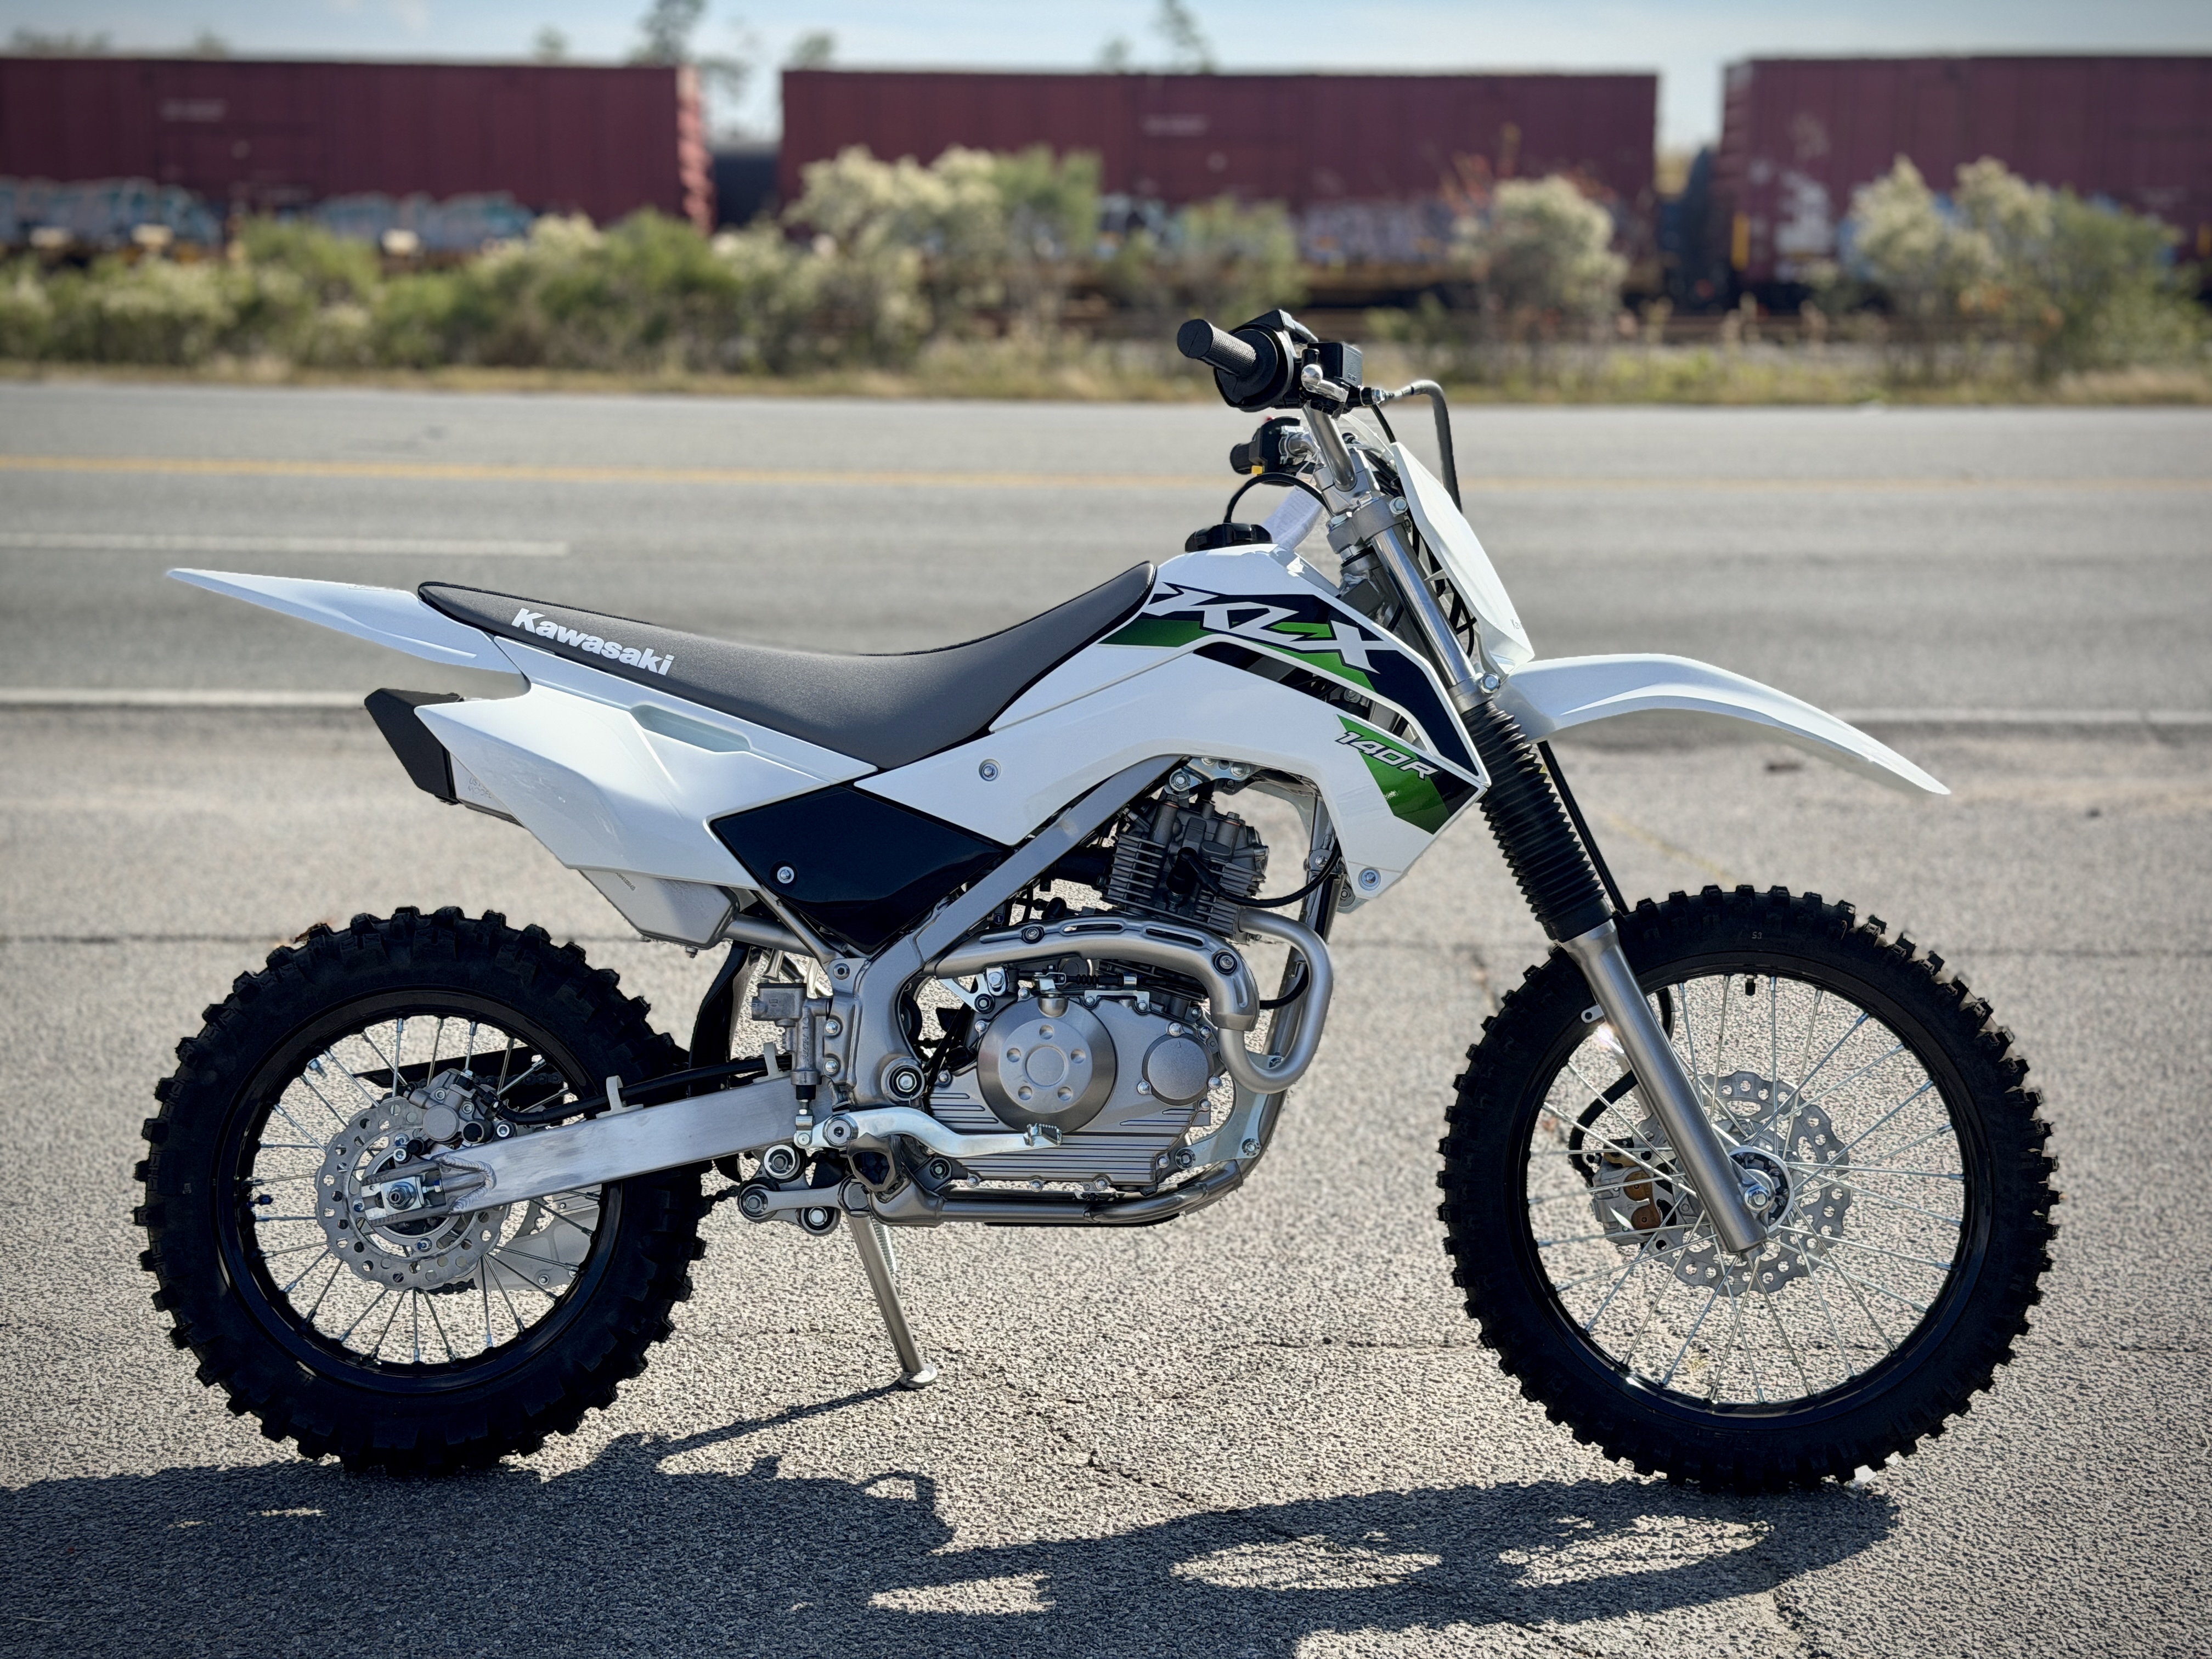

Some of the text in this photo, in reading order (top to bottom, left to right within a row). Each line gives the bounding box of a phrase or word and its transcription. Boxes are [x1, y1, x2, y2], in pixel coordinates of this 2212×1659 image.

[511, 608, 674, 676] Kawasaki
[1142, 582, 1387, 674] KLX
[1335, 730, 1440, 781] 140R
